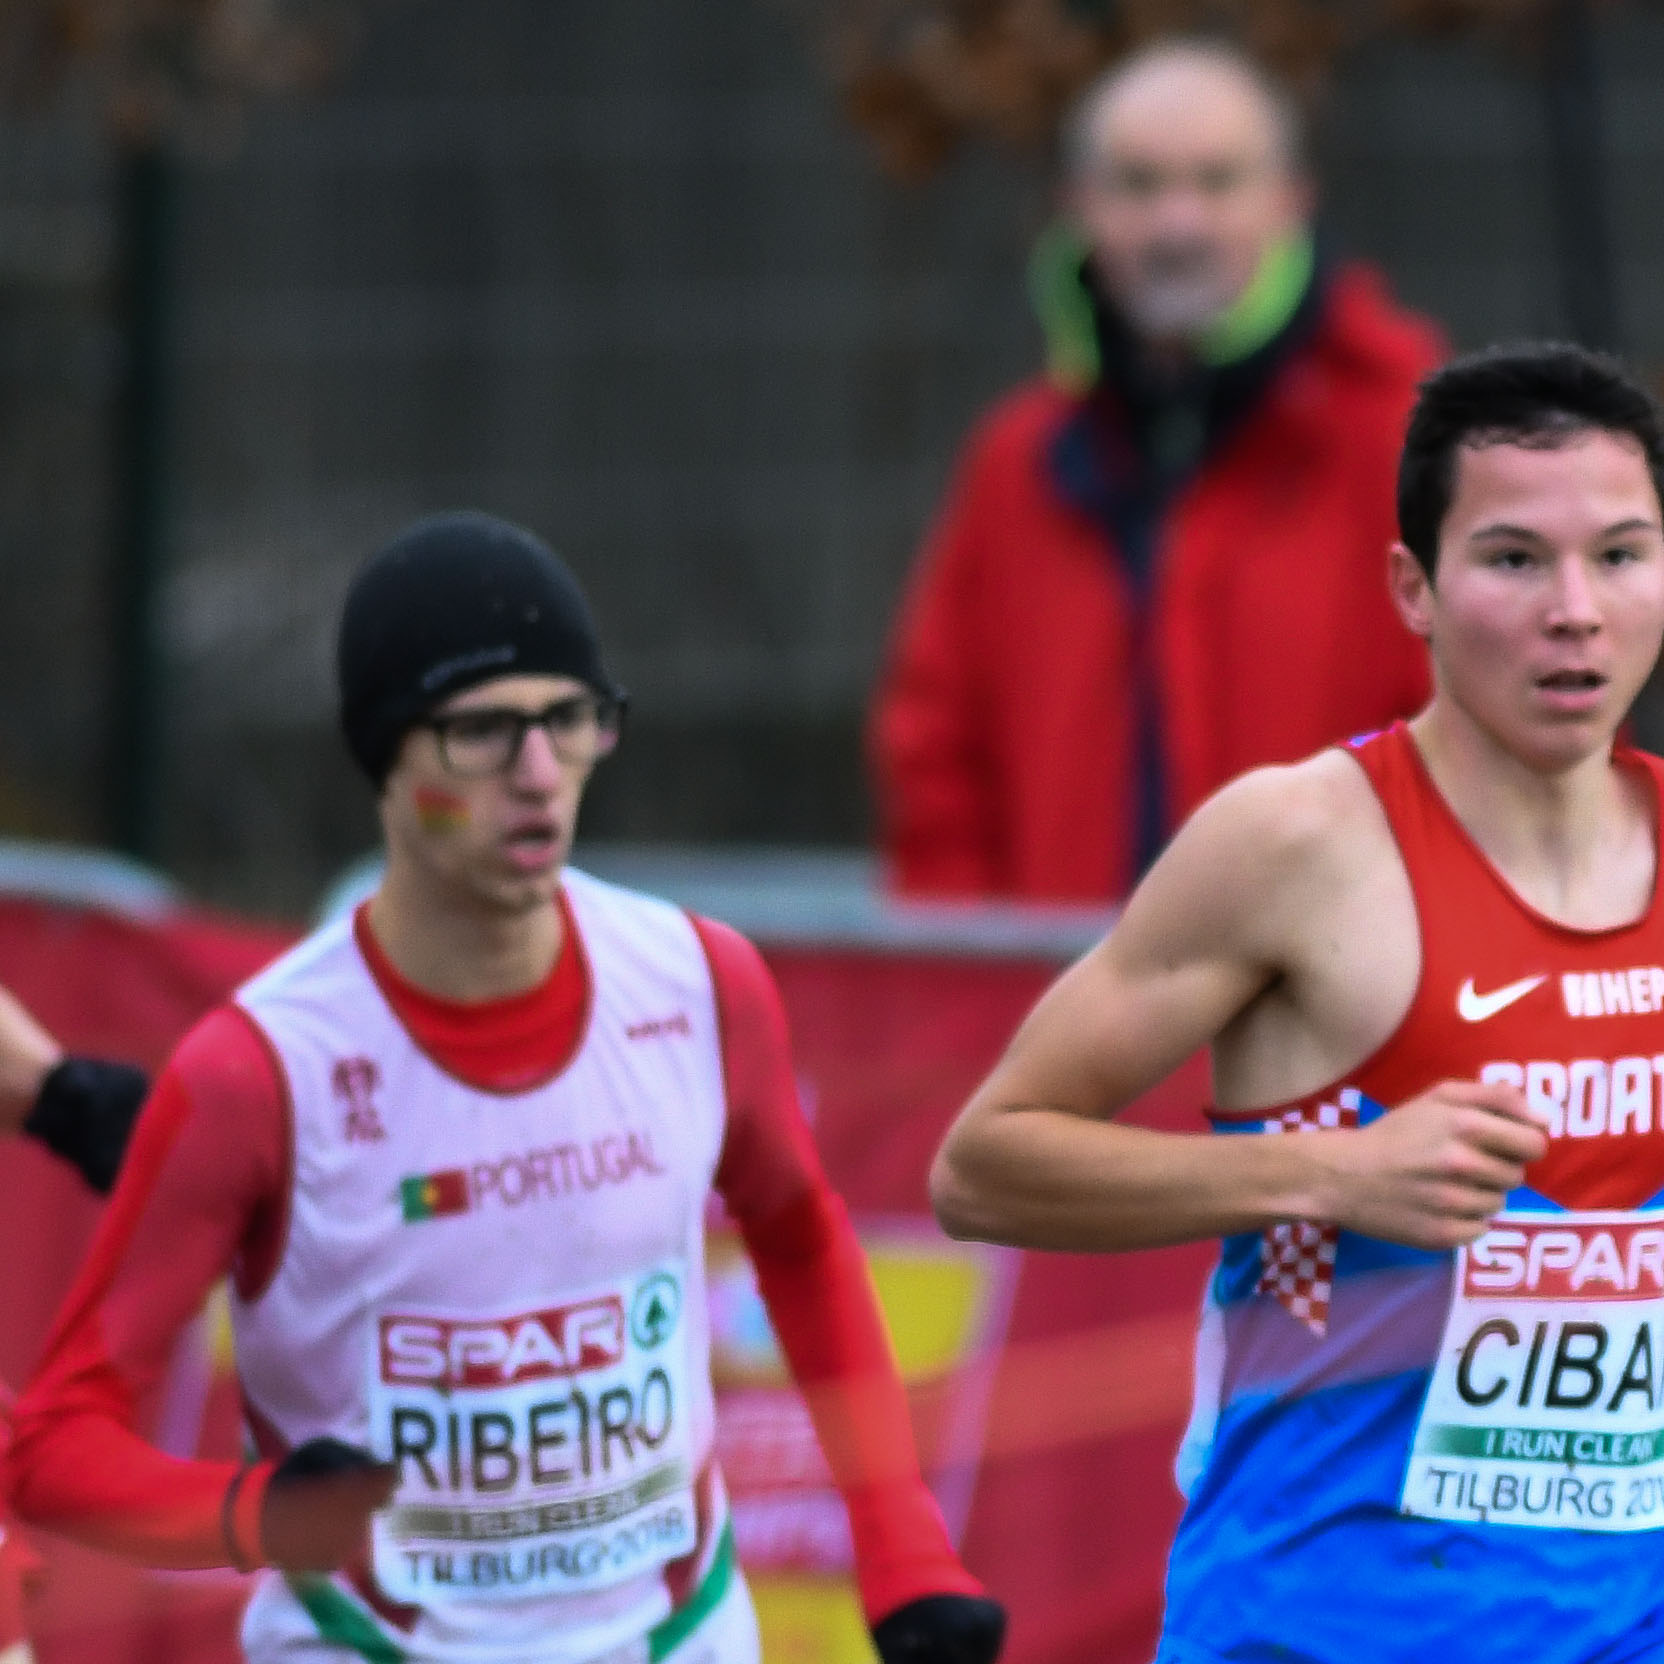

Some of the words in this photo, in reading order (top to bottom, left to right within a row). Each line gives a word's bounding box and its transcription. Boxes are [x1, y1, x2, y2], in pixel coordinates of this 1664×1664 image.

[471, 1130, 666, 1209] PORTUGAL
[385, 1303, 621, 1381] SPAR
[391, 1367, 672, 1493] RIBEIRO
[1485, 1428, 1497, 1456] I
[1500, 1428, 1567, 1458] RUN
[1428, 1465, 1615, 1519] TILBURG
[404, 1538, 606, 1587] TILBURG
